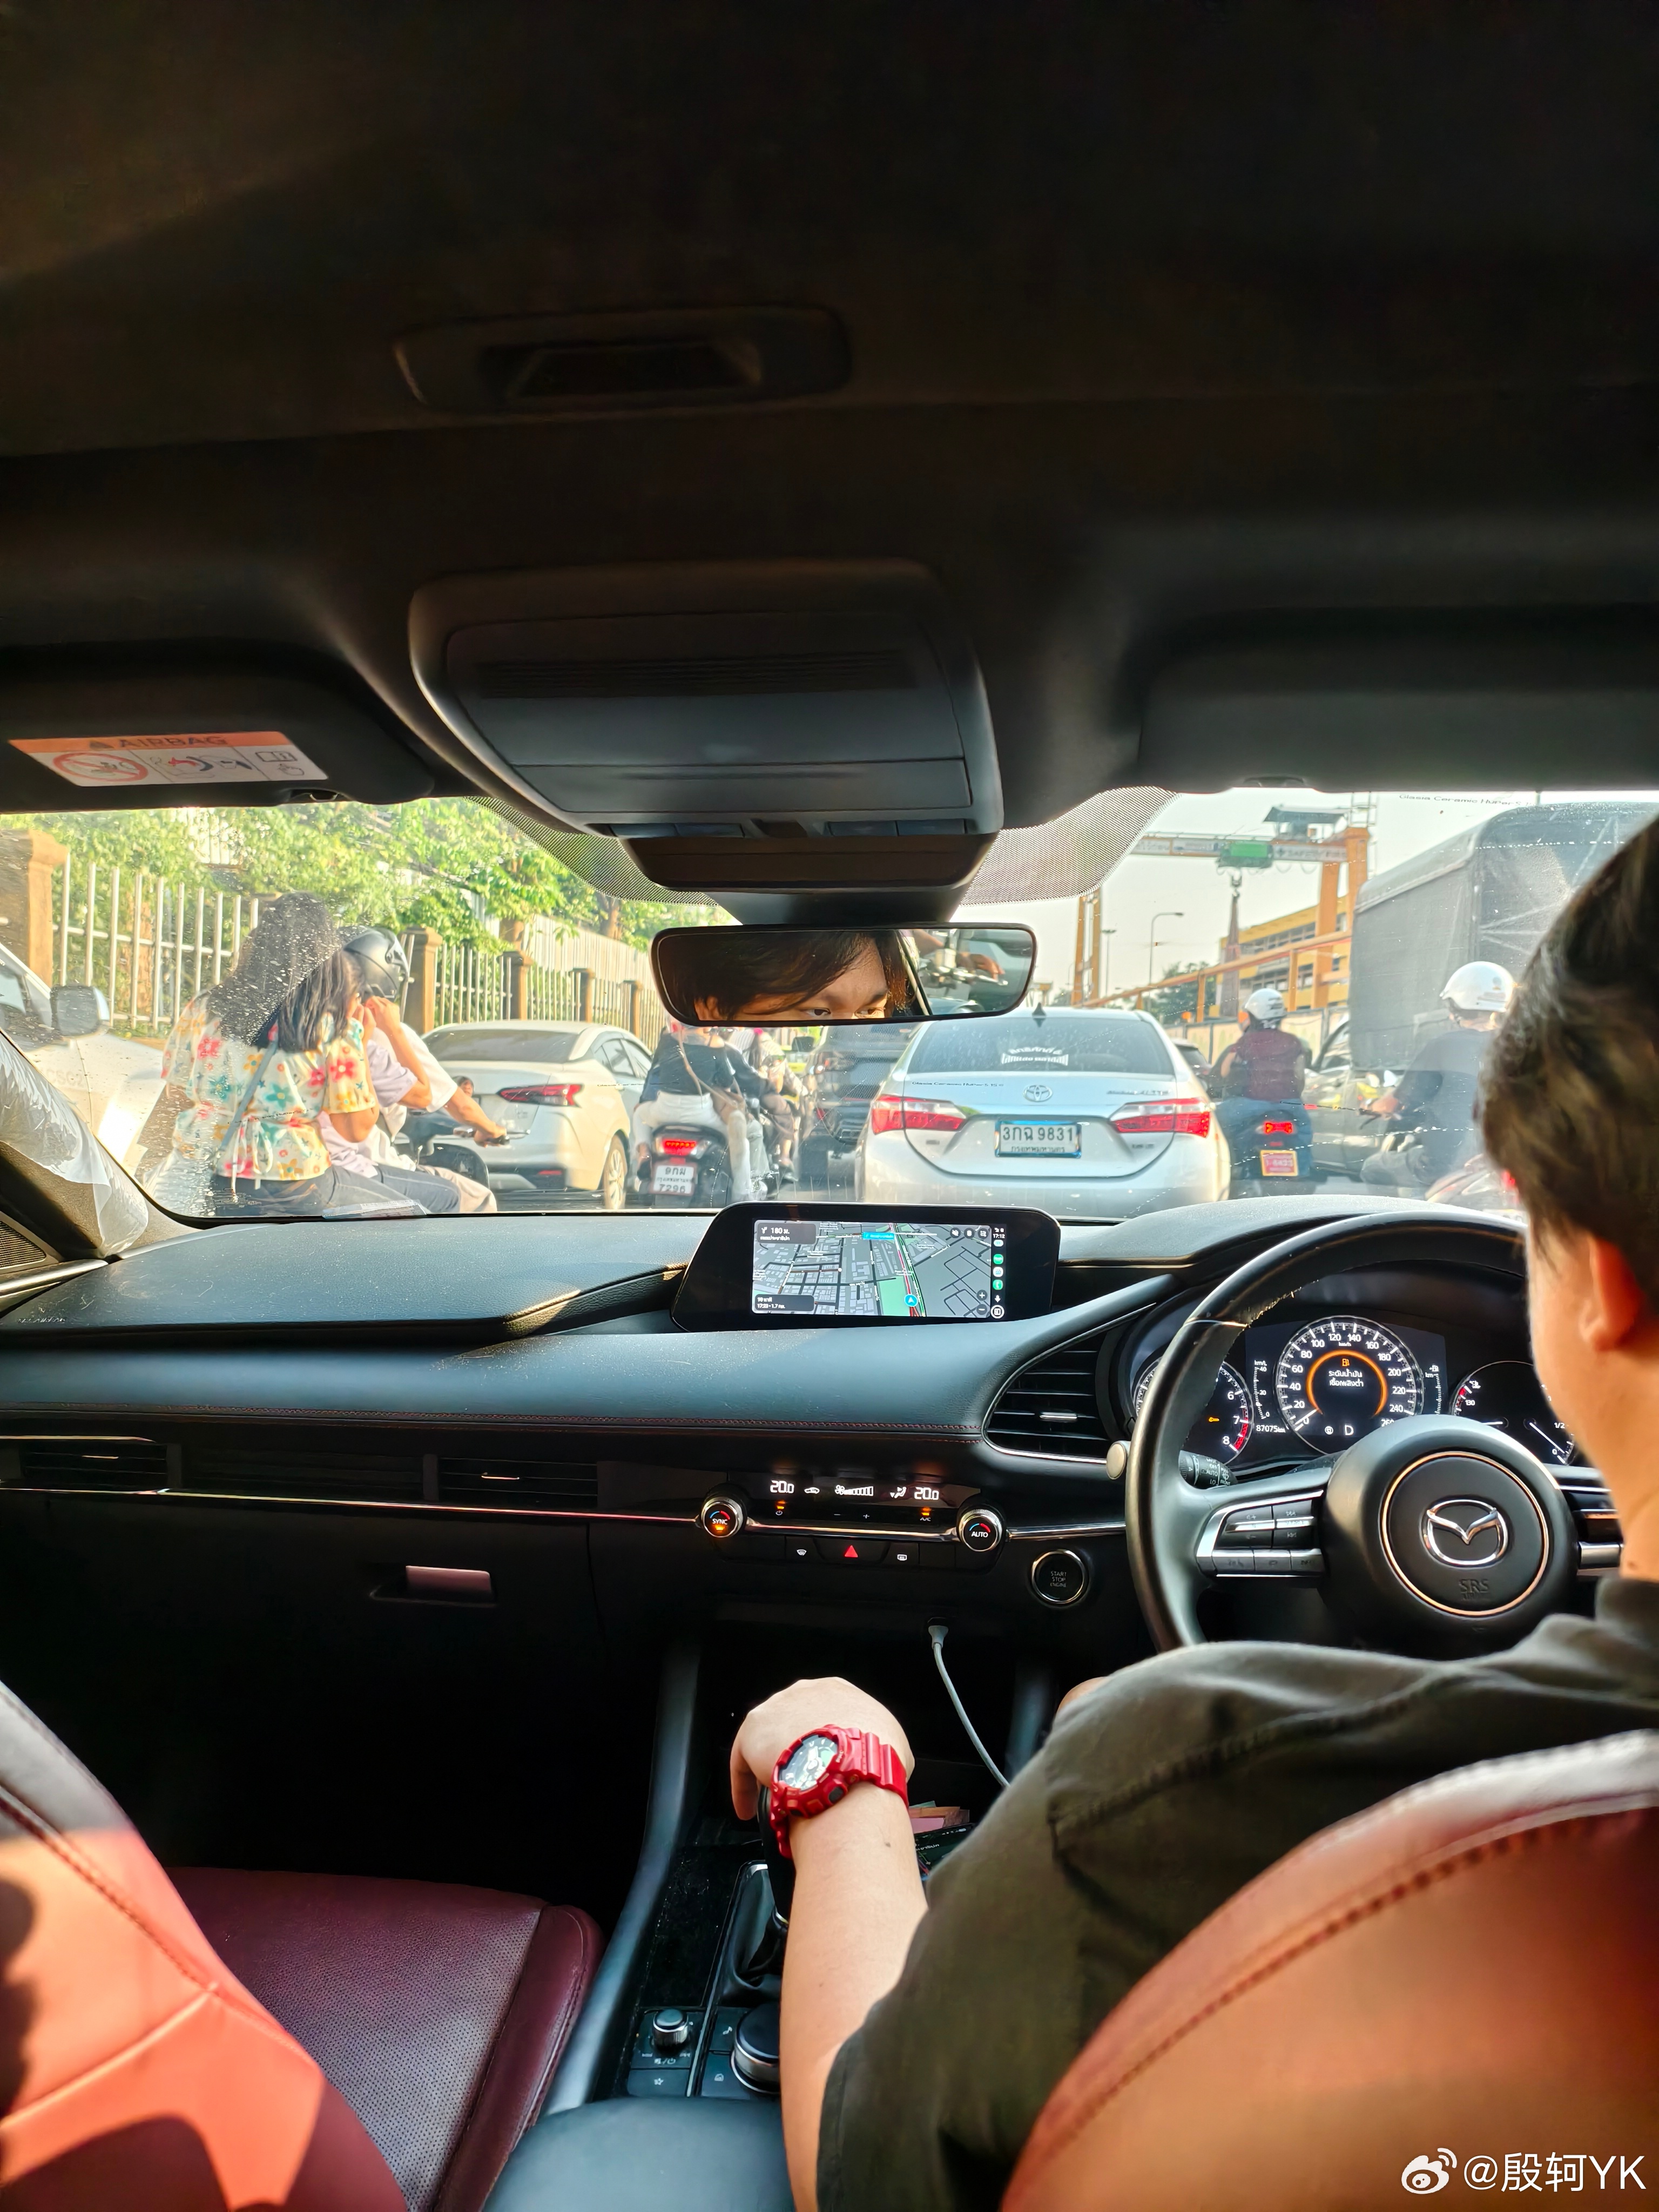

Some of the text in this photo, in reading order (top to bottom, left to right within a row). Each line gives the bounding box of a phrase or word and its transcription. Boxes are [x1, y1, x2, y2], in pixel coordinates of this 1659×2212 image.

[119, 736, 228, 747] AIRBAG
[1037, 1127, 1073, 1141] 9831
[659, 1184, 686, 1193] 7296
[1347, 1334, 1361, 1342] 140
[1300, 1351, 1312, 1359] 80
[1378, 1353, 1391, 1361] 180
[1388, 1368, 1401, 1377] 200
[1392, 1386, 1406, 1394] 220
[1227, 1391, 1235, 1400] 6
[1293, 1400, 1305, 1408] 20
[1233, 1415, 1240, 1424] 7
[1345, 1425, 1354, 1435] D
[1223, 1435, 1230, 1445] 8
[770, 1480, 794, 1493] 20.0
[914, 1487, 939, 1500] 20.0
[1458, 1579, 1489, 1593] SRS
